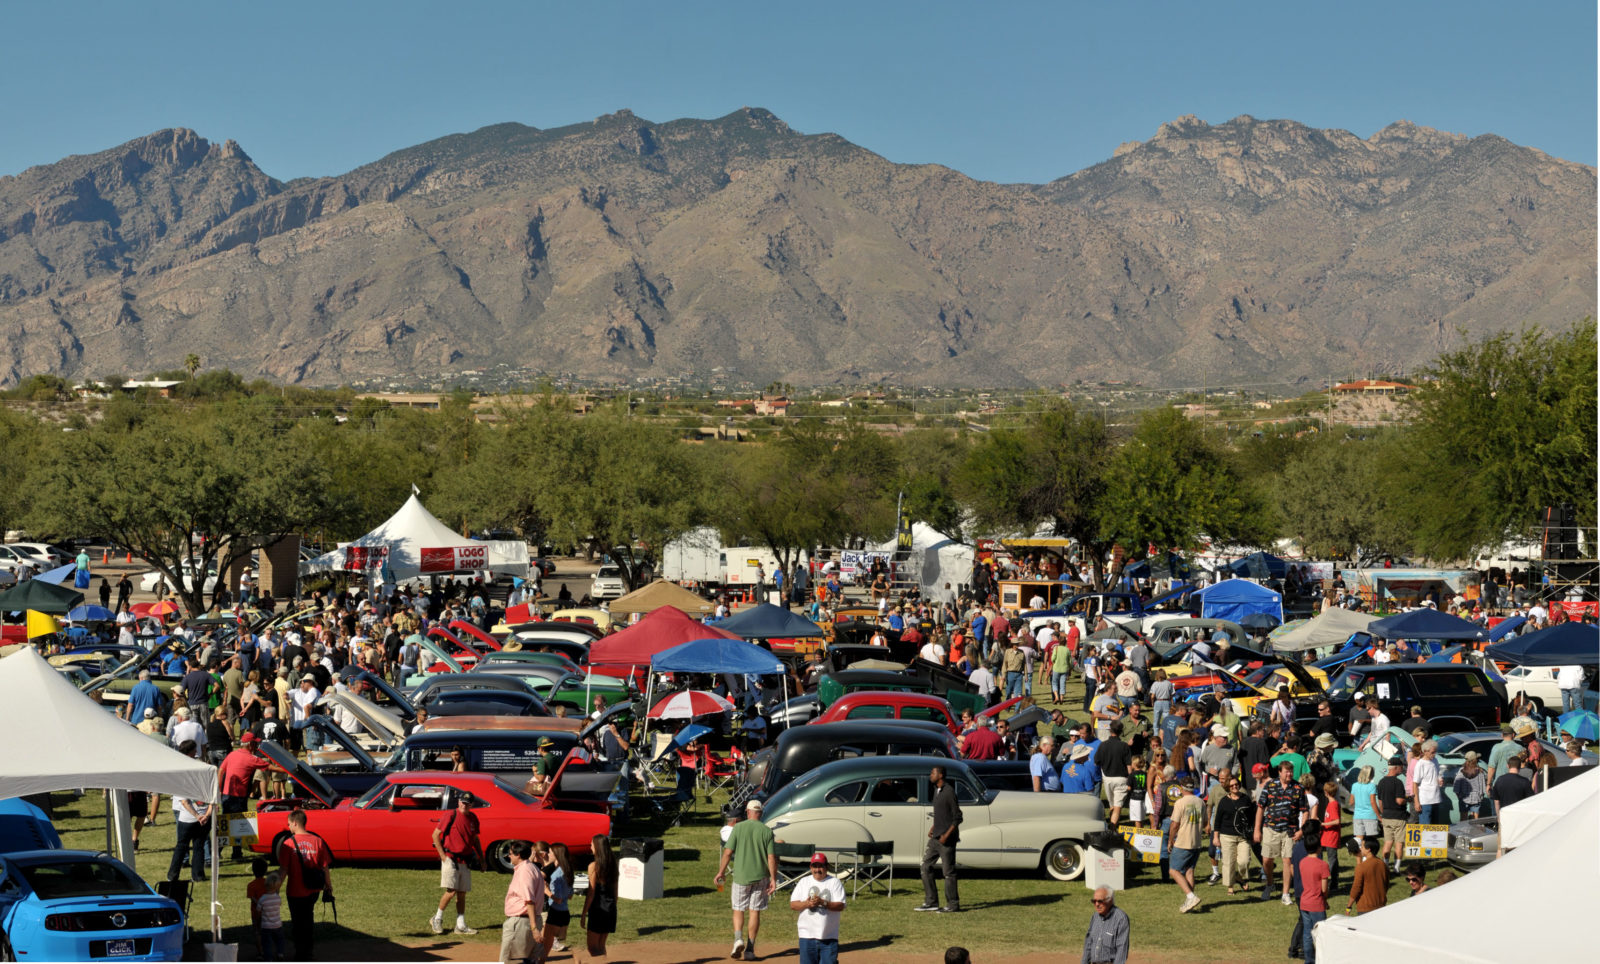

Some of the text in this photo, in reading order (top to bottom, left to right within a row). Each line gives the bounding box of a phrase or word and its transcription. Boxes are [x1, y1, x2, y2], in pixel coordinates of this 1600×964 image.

[459, 548, 484, 558] LOGO
[842, 553, 859, 563] Jack
[460, 561, 484, 569] SHOP
[1136, 829, 1162, 837] SPONSOR
[1407, 830, 1421, 842] 16
[1409, 848, 1418, 856] 17
